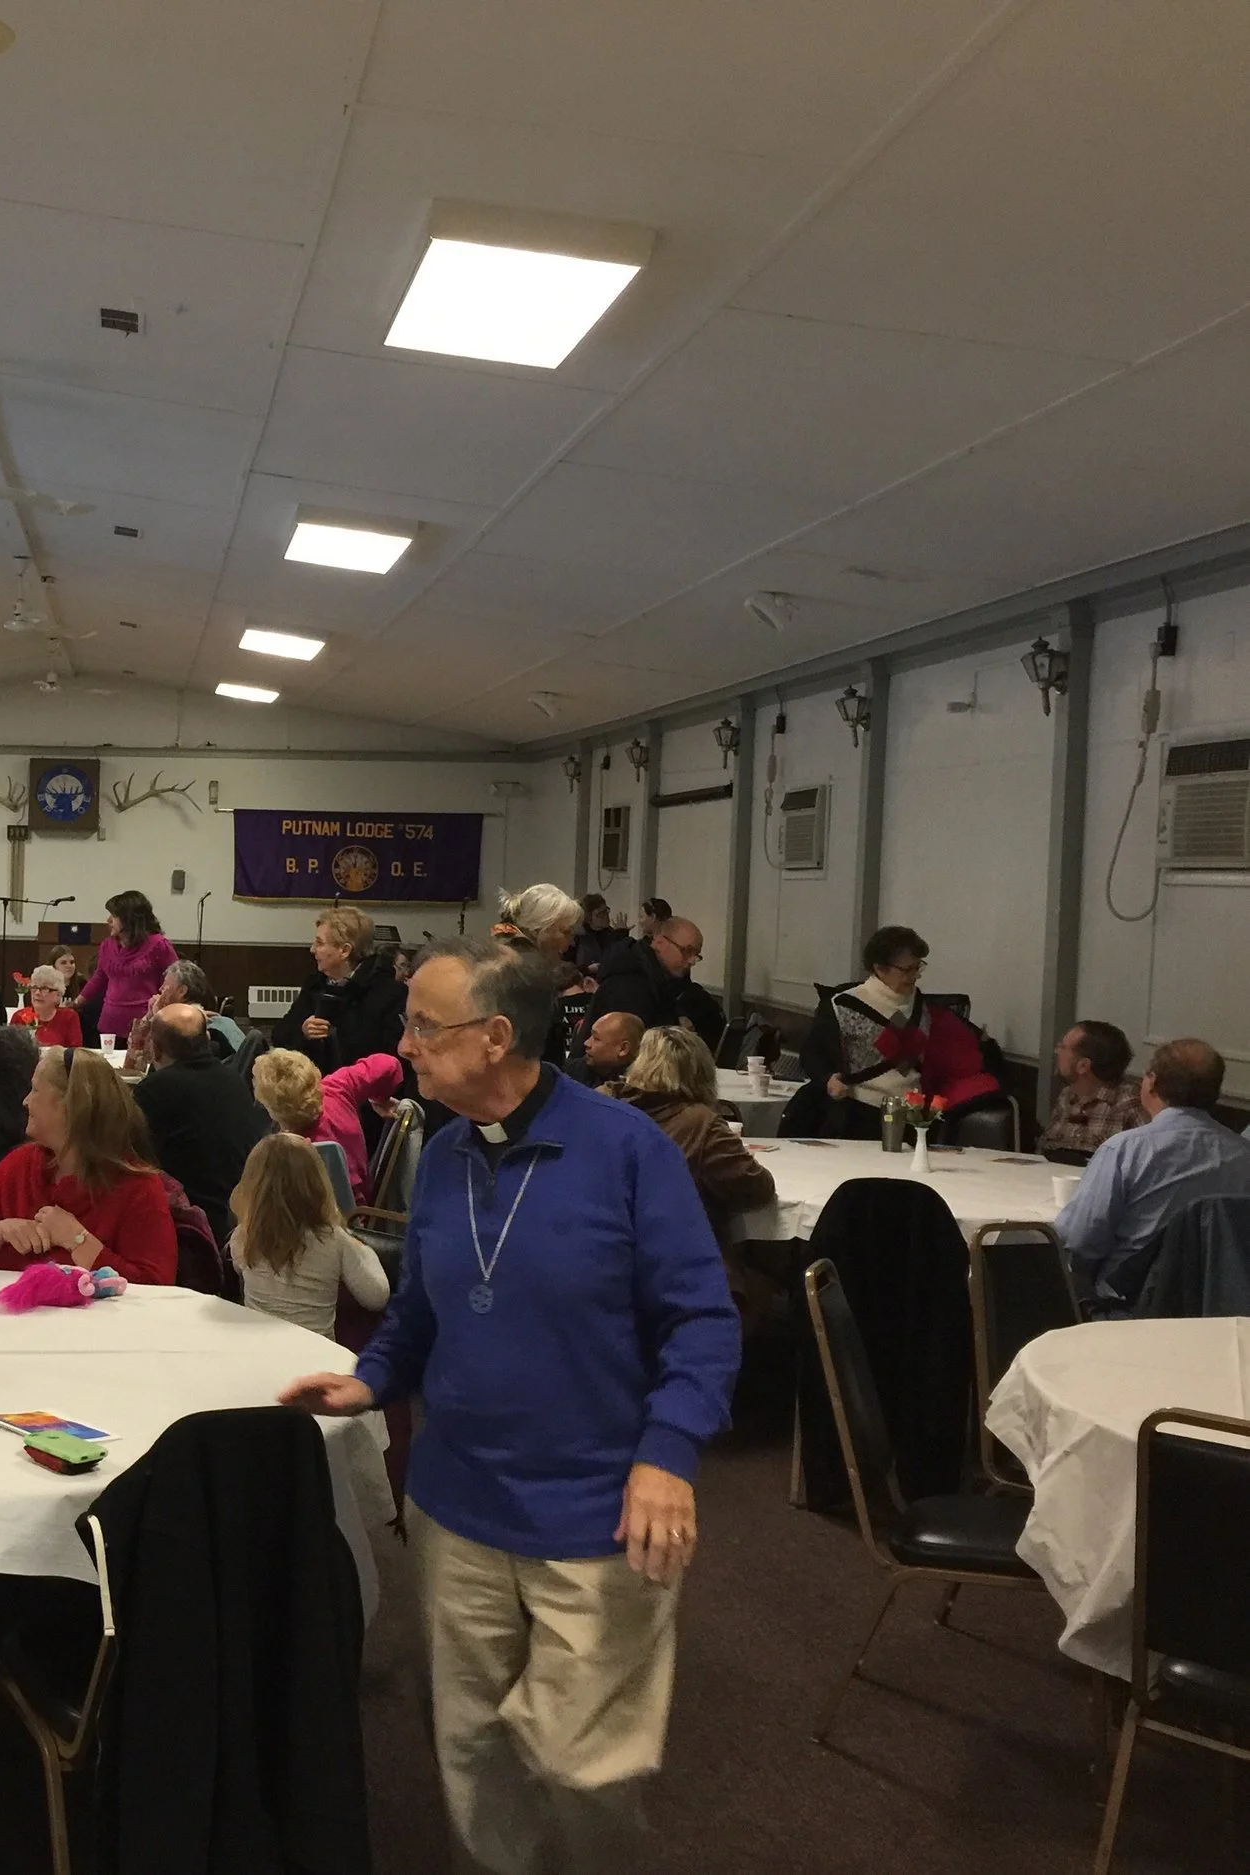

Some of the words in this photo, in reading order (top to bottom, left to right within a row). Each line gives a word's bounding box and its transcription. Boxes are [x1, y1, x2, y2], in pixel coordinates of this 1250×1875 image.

[282, 820, 340, 836] PUTNAM
[346, 822, 395, 838] LODGE
[286, 857, 299, 873] B.
[308, 858, 319, 873] P.
[391, 861, 405, 877] O.
[413, 861, 427, 877] E.
[564, 1005, 586, 1014] LIFE
